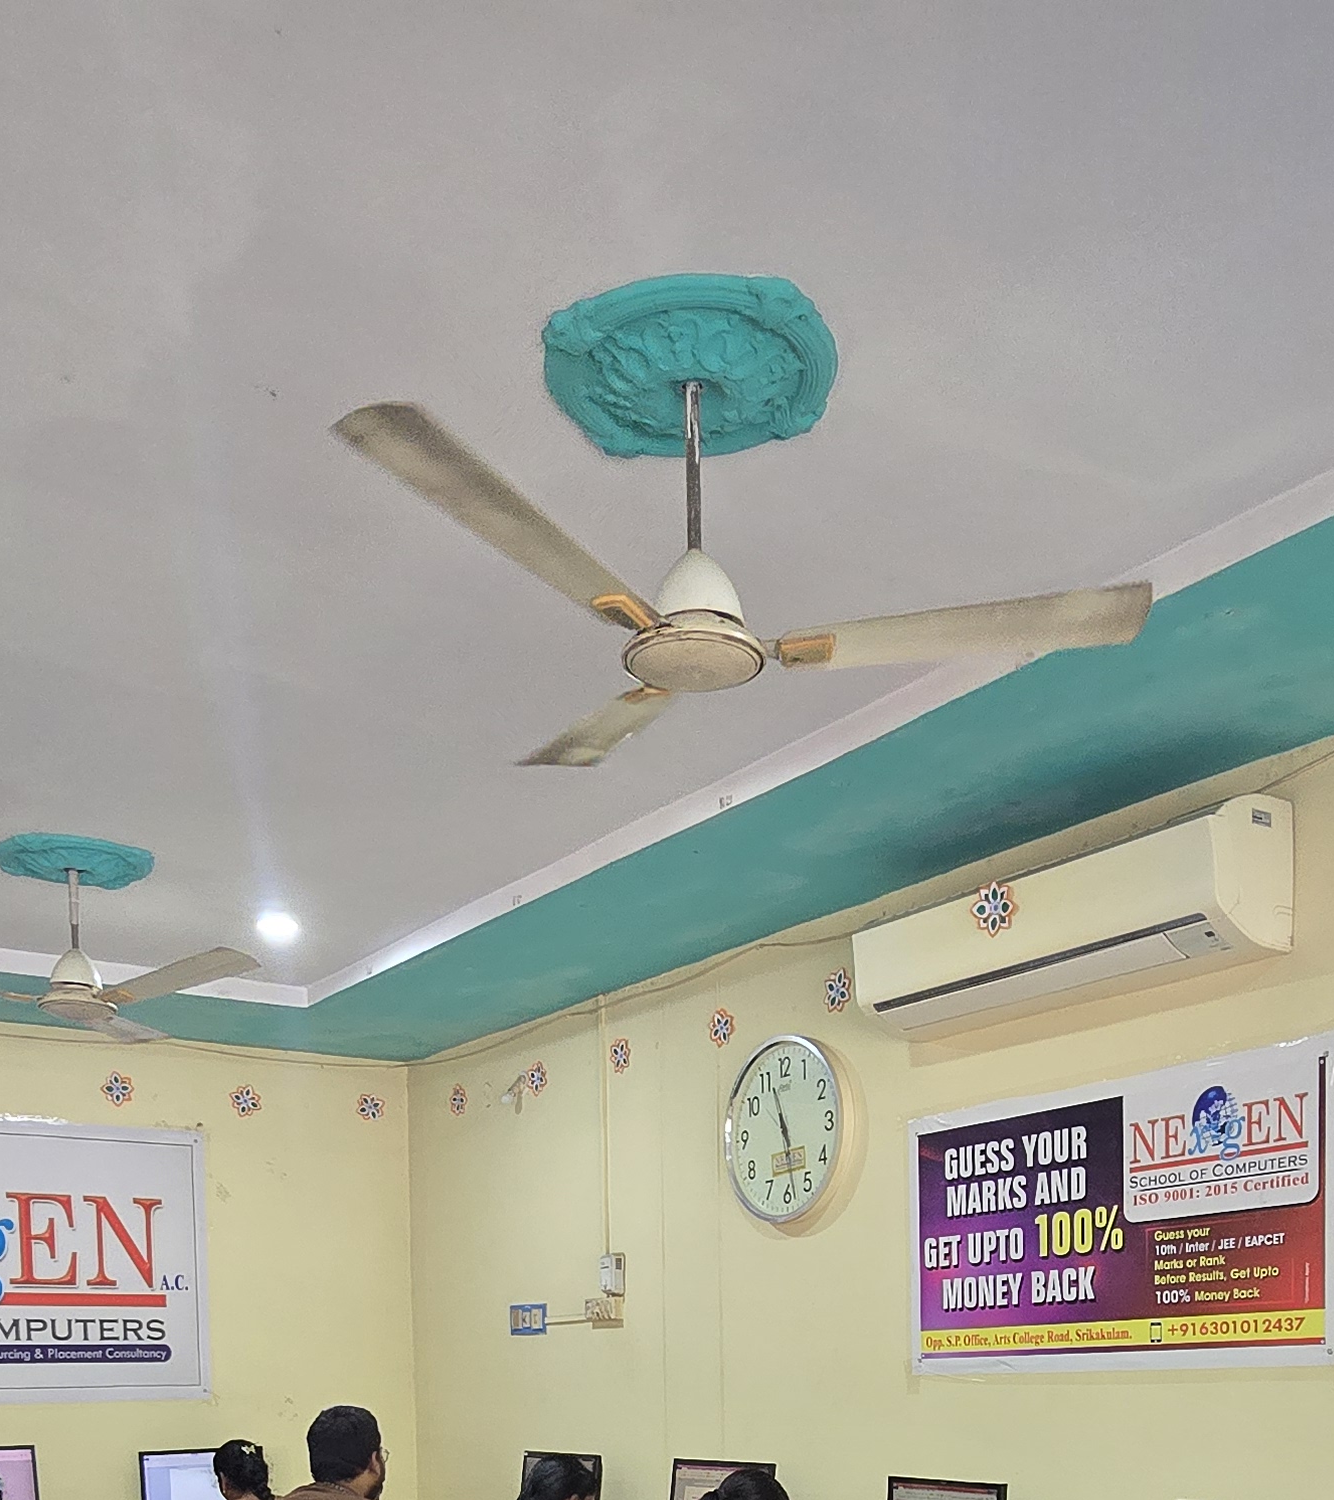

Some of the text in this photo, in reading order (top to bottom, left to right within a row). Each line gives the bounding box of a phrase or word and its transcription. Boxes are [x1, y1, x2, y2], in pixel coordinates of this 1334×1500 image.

[778, 1056, 791, 1078] 12
[801, 1059, 807, 1080] 1
[759, 1072, 771, 1094] 11
[817, 1078, 827, 1100] 2
[747, 1096, 760, 1117] 10
[824, 1109, 834, 1131] 3
[741, 1130, 749, 1150] 9
[818, 1144, 827, 1165] 4
[944, 1126, 1088, 1181] GUESS YOUR
[747, 1160, 756, 1180] 8
[1129, 1154, 1308, 1189] SCHOOL OF COMPUTERS
[765, 1179, 774, 1201] 7
[803, 1171, 812, 1192] 5
[1133, 1172, 1309, 1206] ISO 9001: 2015 Certified
[783, 1184, 792, 1204] 6
[946, 1167, 1086, 1218] MARKS AND
[924, 1204, 1124, 1269] GET UPTO 100%
[1154, 1227, 1211, 1241] Guess your
[1155, 1244, 1177, 1256] 10th
[1186, 1241, 1210, 1253] Inter
[1218, 1237, 1236, 1250] JEE
[1245, 1232, 1285, 1248] EAPCET
[1154, 1254, 1226, 1271] Marks or Rank
[159, 1274, 189, 1292] A.C.
[1154, 1266, 1280, 1286] Before Results, Get Upto
[942, 1266, 1095, 1310] MONEY BACK
[1155, 1287, 1260, 1304] 100% Money Back
[1167, 1317, 1306, 1336] +916301012437
[926, 1327, 1133, 1350] Opp. S.P. Office, Arts College Road, Srikakulam.
[34, 1347, 44, 1359] &
[48, 1348, 102, 1360] Placement
[105, 1347, 167, 1361] Consultancy
